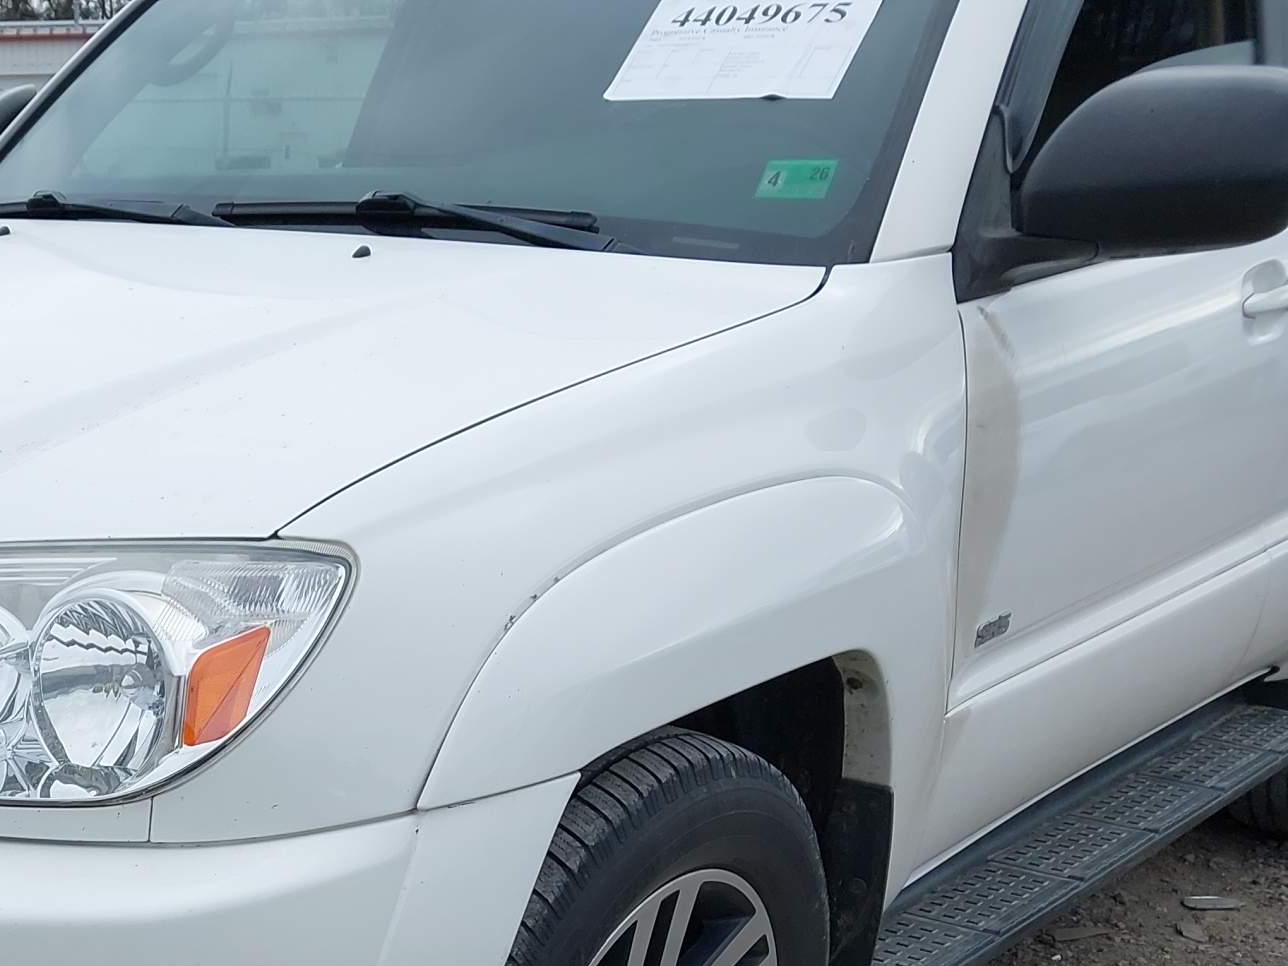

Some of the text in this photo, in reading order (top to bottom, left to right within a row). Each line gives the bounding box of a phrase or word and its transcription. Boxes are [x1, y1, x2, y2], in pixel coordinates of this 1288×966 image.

[672, 2, 853, 27] 44049675
[767, 166, 831, 187] 4 26
